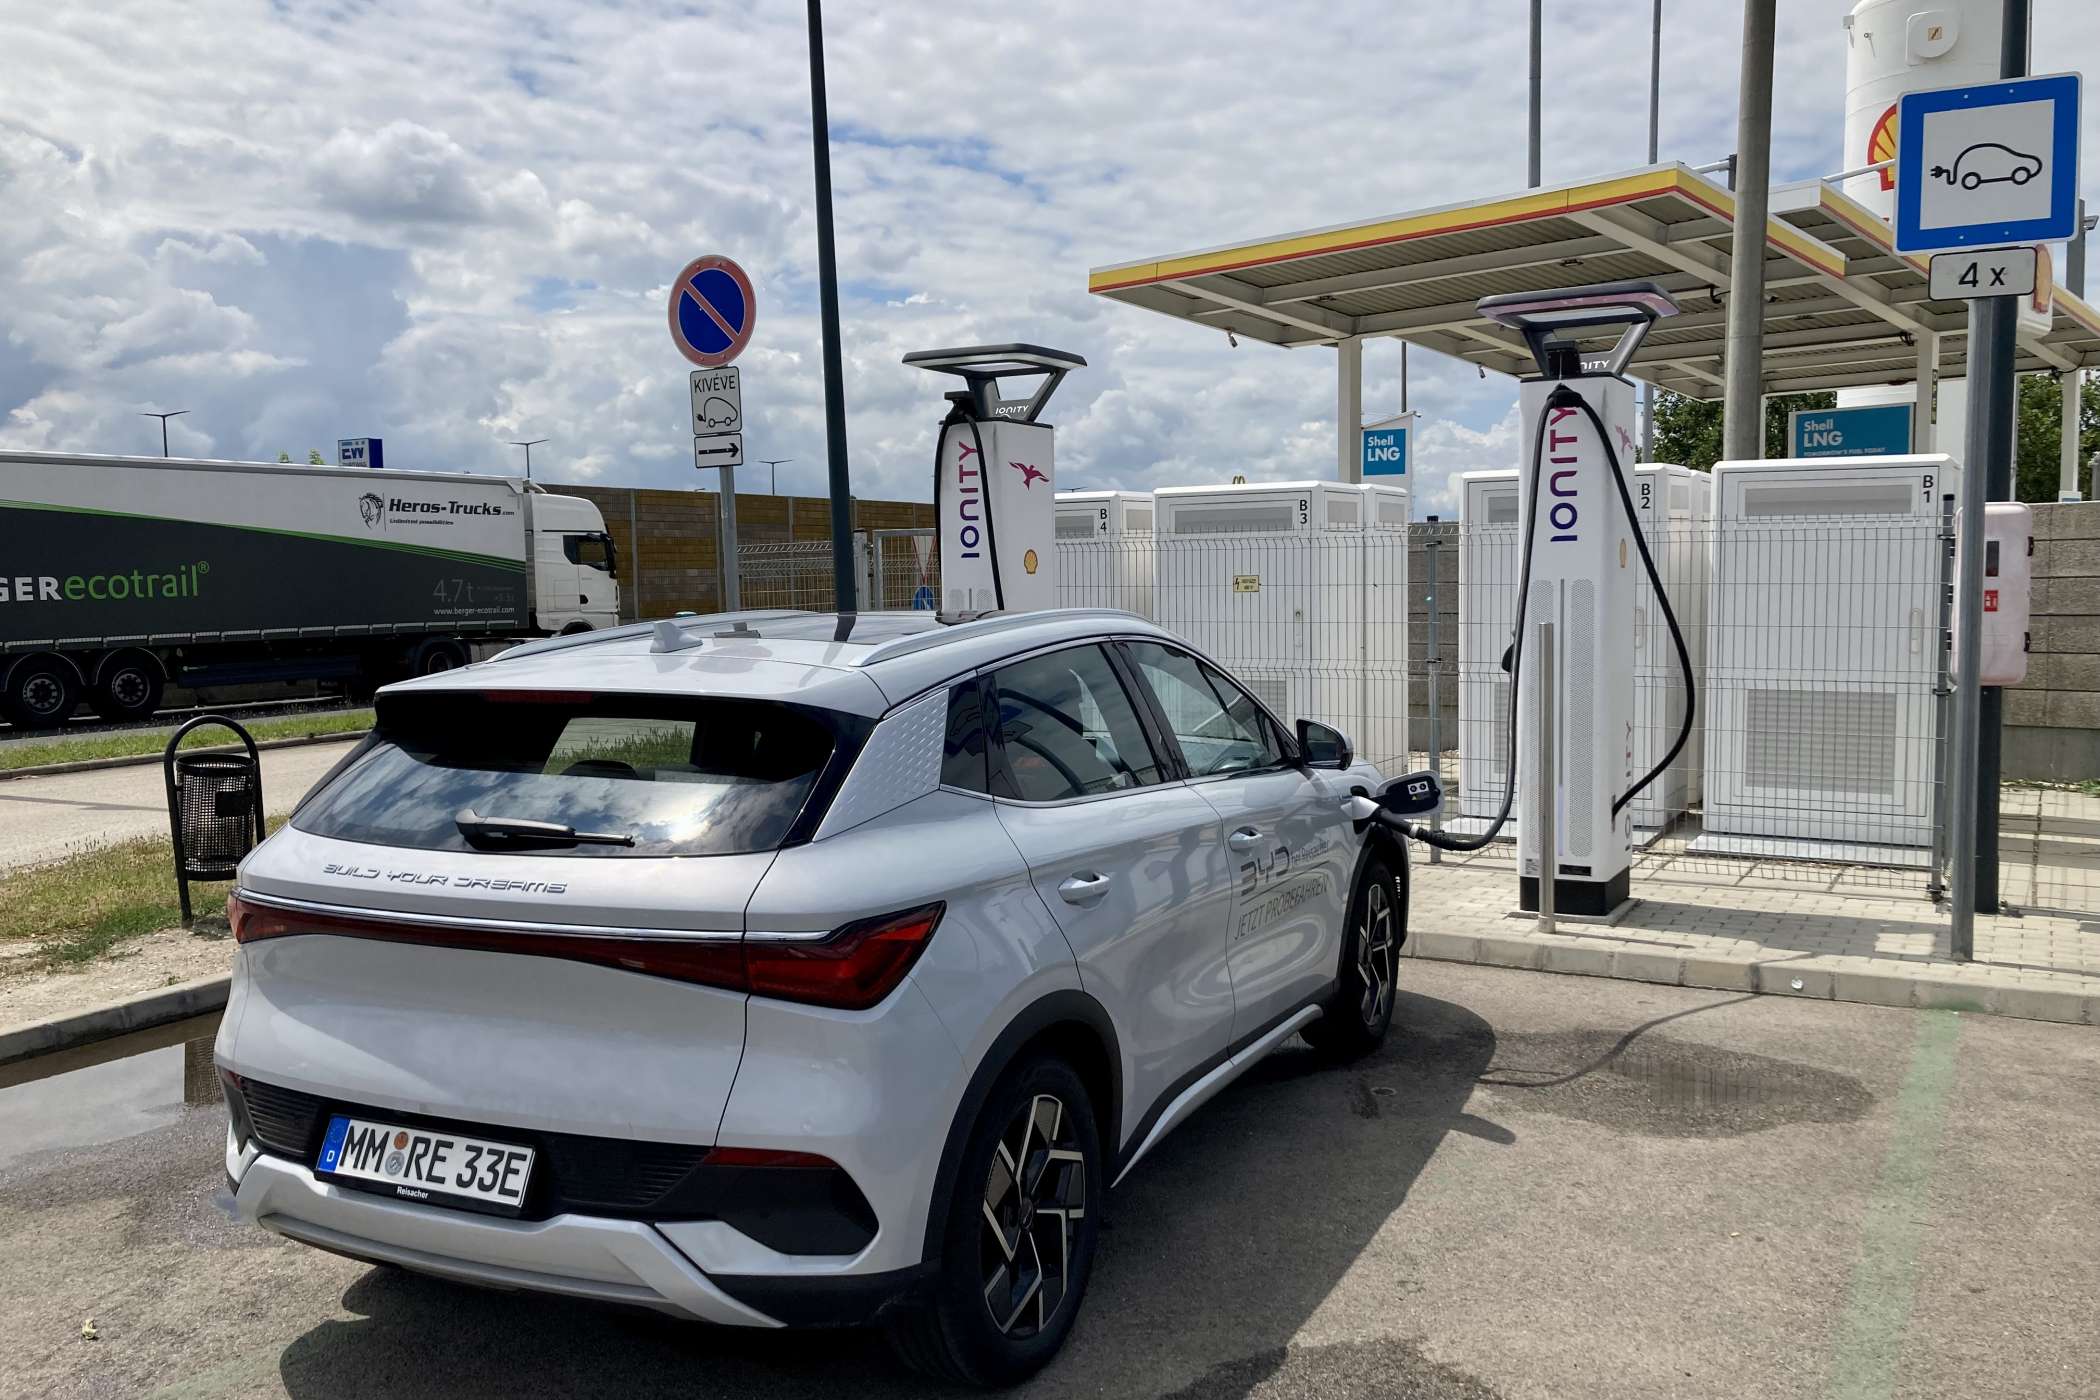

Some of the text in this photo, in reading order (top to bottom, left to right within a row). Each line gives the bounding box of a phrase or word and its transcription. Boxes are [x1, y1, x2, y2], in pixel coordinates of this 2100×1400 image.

[1958, 262, 2006, 288] 4 x
[1580, 359, 1610, 370] NITY
[694, 373, 736, 393] KIVÉVE
[995, 404, 1029, 415] IONITY
[1804, 418, 1833, 431] Shell
[1367, 434, 1394, 447] Shell
[1803, 431, 1843, 447] LNG
[1367, 446, 1400, 462] LNG
[1549, 407, 1578, 543] IONITY
[1923, 475, 1933, 489] B
[1641, 483, 1651, 496] B
[958, 440, 980, 559] IONITY
[1640, 497, 1650, 509] 2
[1923, 490, 1931, 503] 1
[1300, 500, 1308, 512] B
[1100, 509, 1107, 520] B
[1300, 512, 1308, 524] 3
[1100, 521, 1107, 532] 4
[323, 863, 568, 894] BUILD YOUR DREAMS
[1233, 903, 1266, 940] JETZT
[326, 1150, 335, 1162] D
[338, 1125, 528, 1198] MM RE 33E
[396, 1186, 429, 1200] Reisacher
